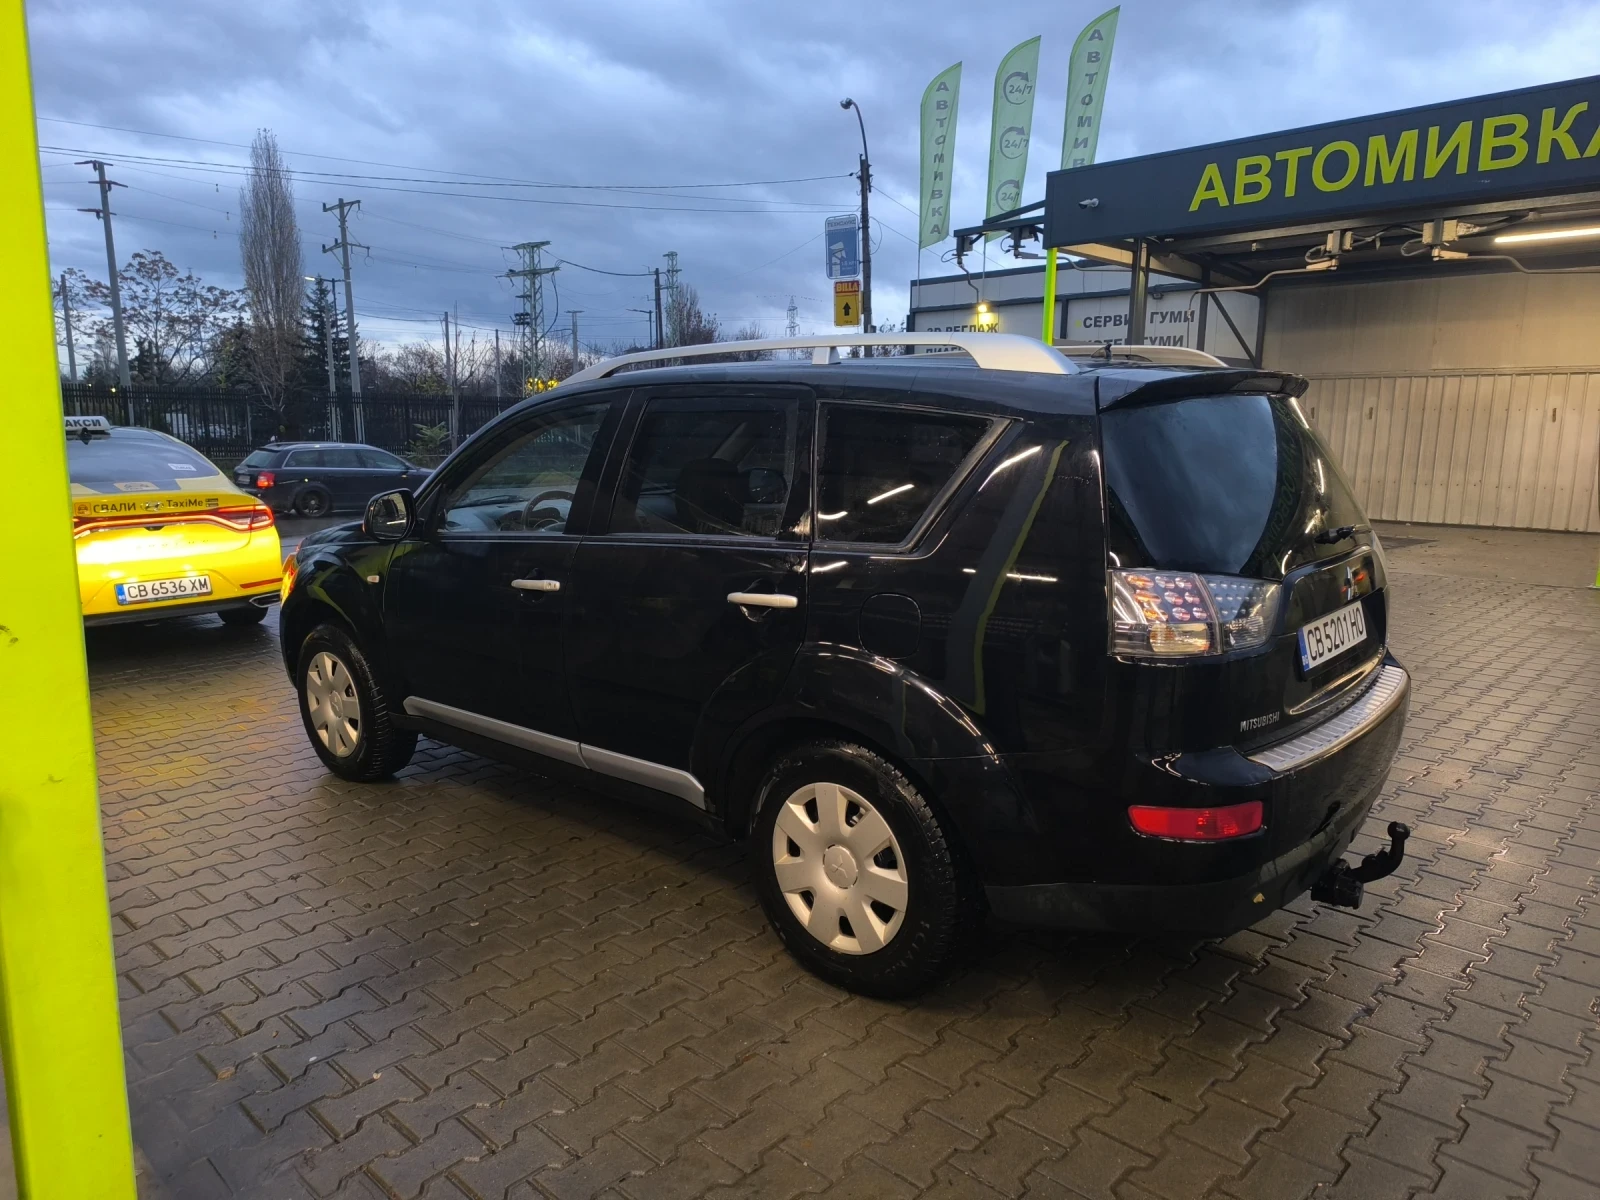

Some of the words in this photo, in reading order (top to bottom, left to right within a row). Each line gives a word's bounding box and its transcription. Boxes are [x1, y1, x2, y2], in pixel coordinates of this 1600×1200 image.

[1008, 84, 1033, 95] 24/7
[1073, 29, 1104, 168] АВТОМИВ
[1004, 138, 1029, 149] 24/7
[930, 81, 949, 235] АВТОМИВКА
[836, 282, 858, 292] BILLA
[1149, 310, 1195, 324] ГУМИ
[65, 418, 101, 427] АКСИ
[93, 502, 137, 513] СВАЛИ
[166, 498, 203, 508] TaxiMe
[128, 584, 148, 599] CB
[152, 580, 187, 595] 6536
[189, 577, 208, 591] XM
[1307, 625, 1325, 661] CB
[1325, 615, 1350, 653] 5201
[1240, 711, 1280, 733] MITSUBISHI
